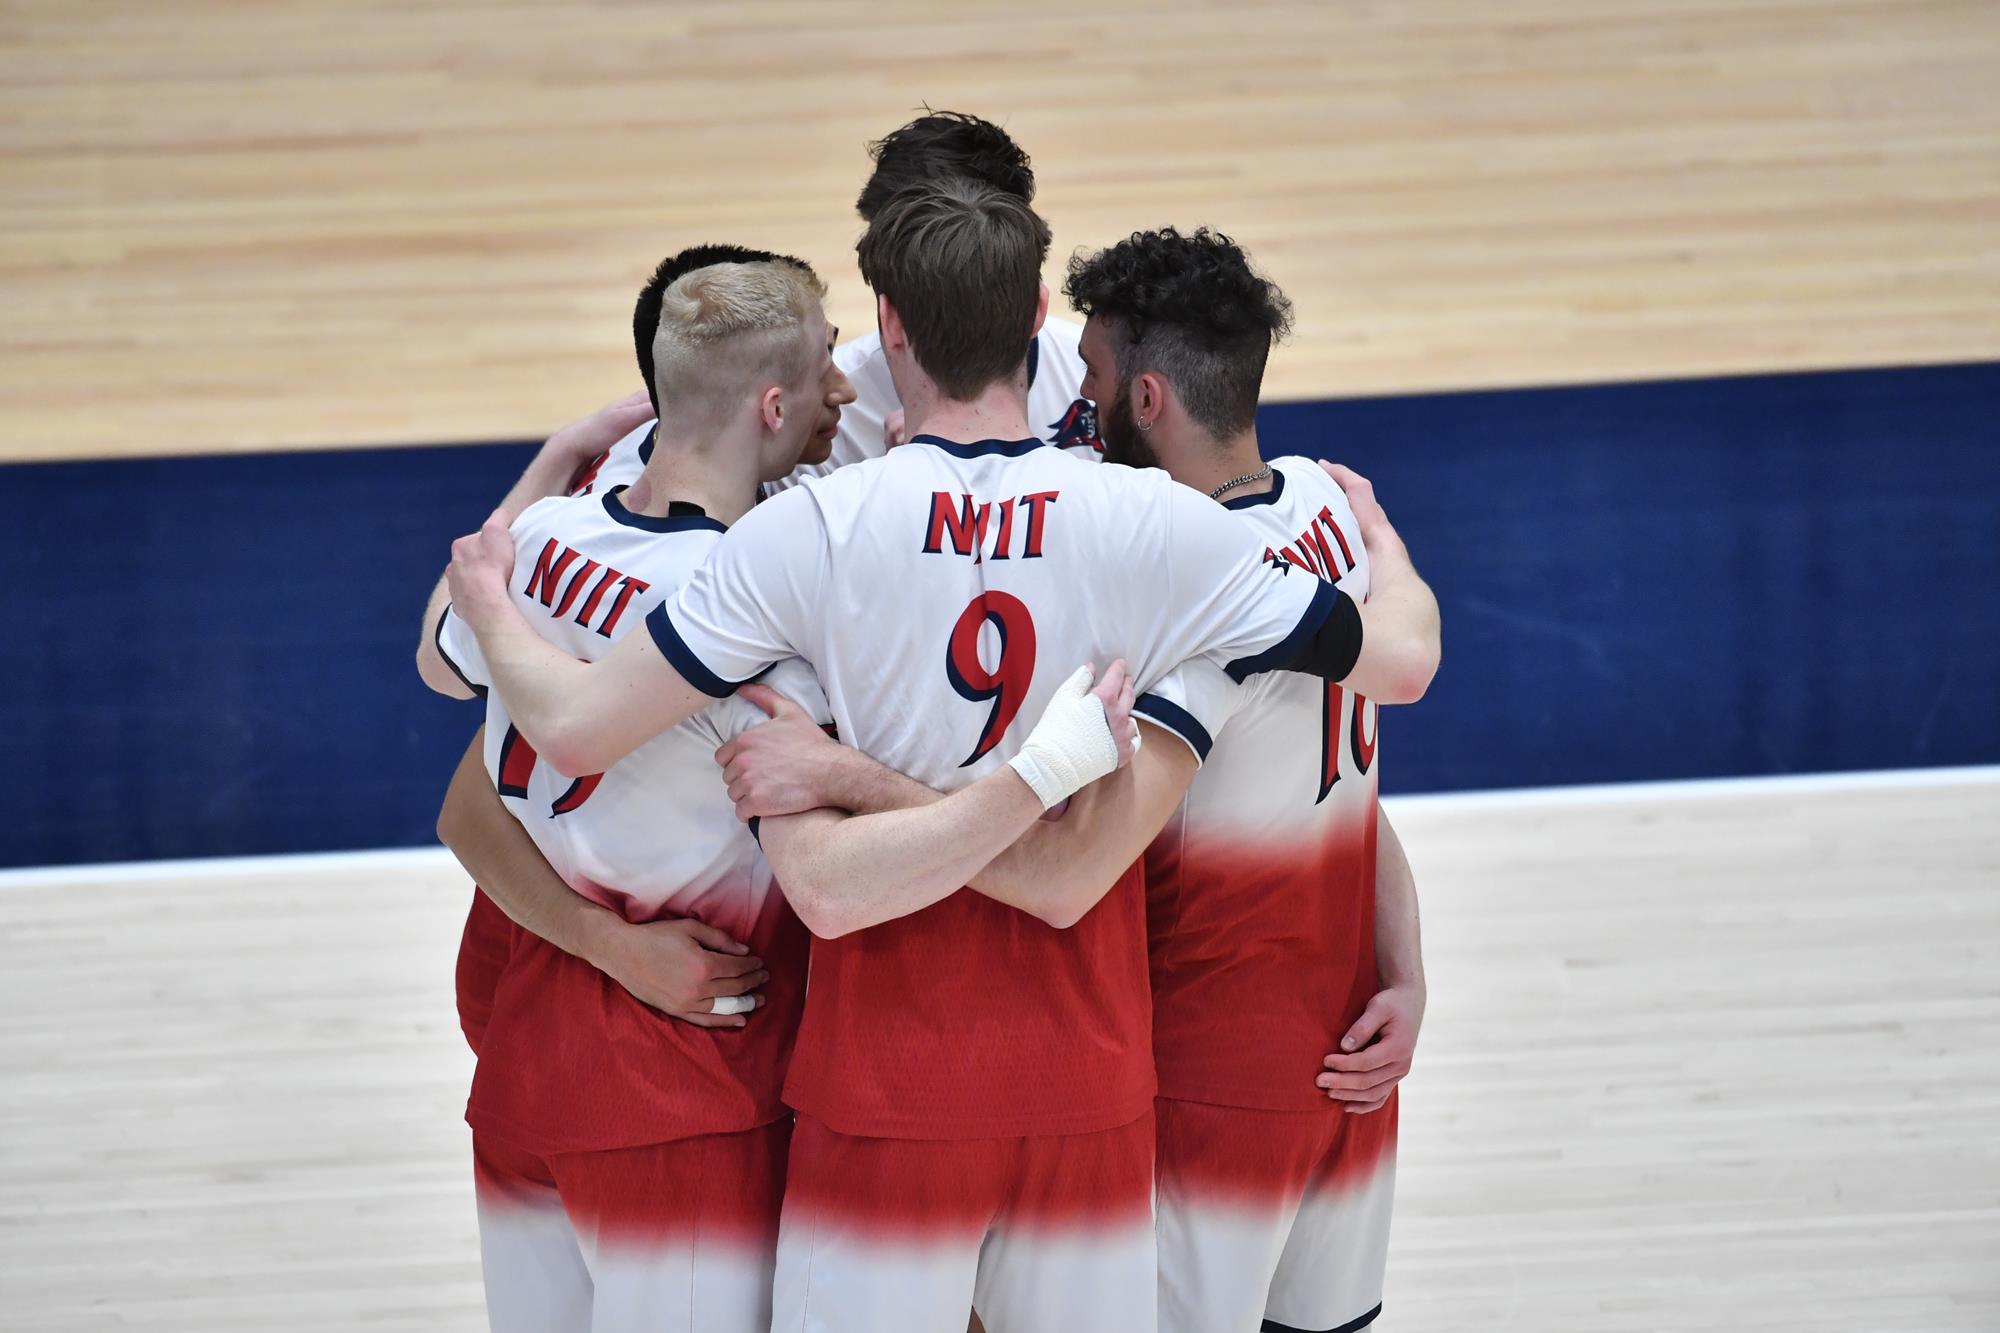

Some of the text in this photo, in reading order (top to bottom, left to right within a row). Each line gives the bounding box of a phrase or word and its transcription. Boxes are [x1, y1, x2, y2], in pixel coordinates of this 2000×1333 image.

[922, 491, 1060, 565] NJIT
[524, 537, 651, 639] NJIT
[945, 590, 1037, 768] 9
